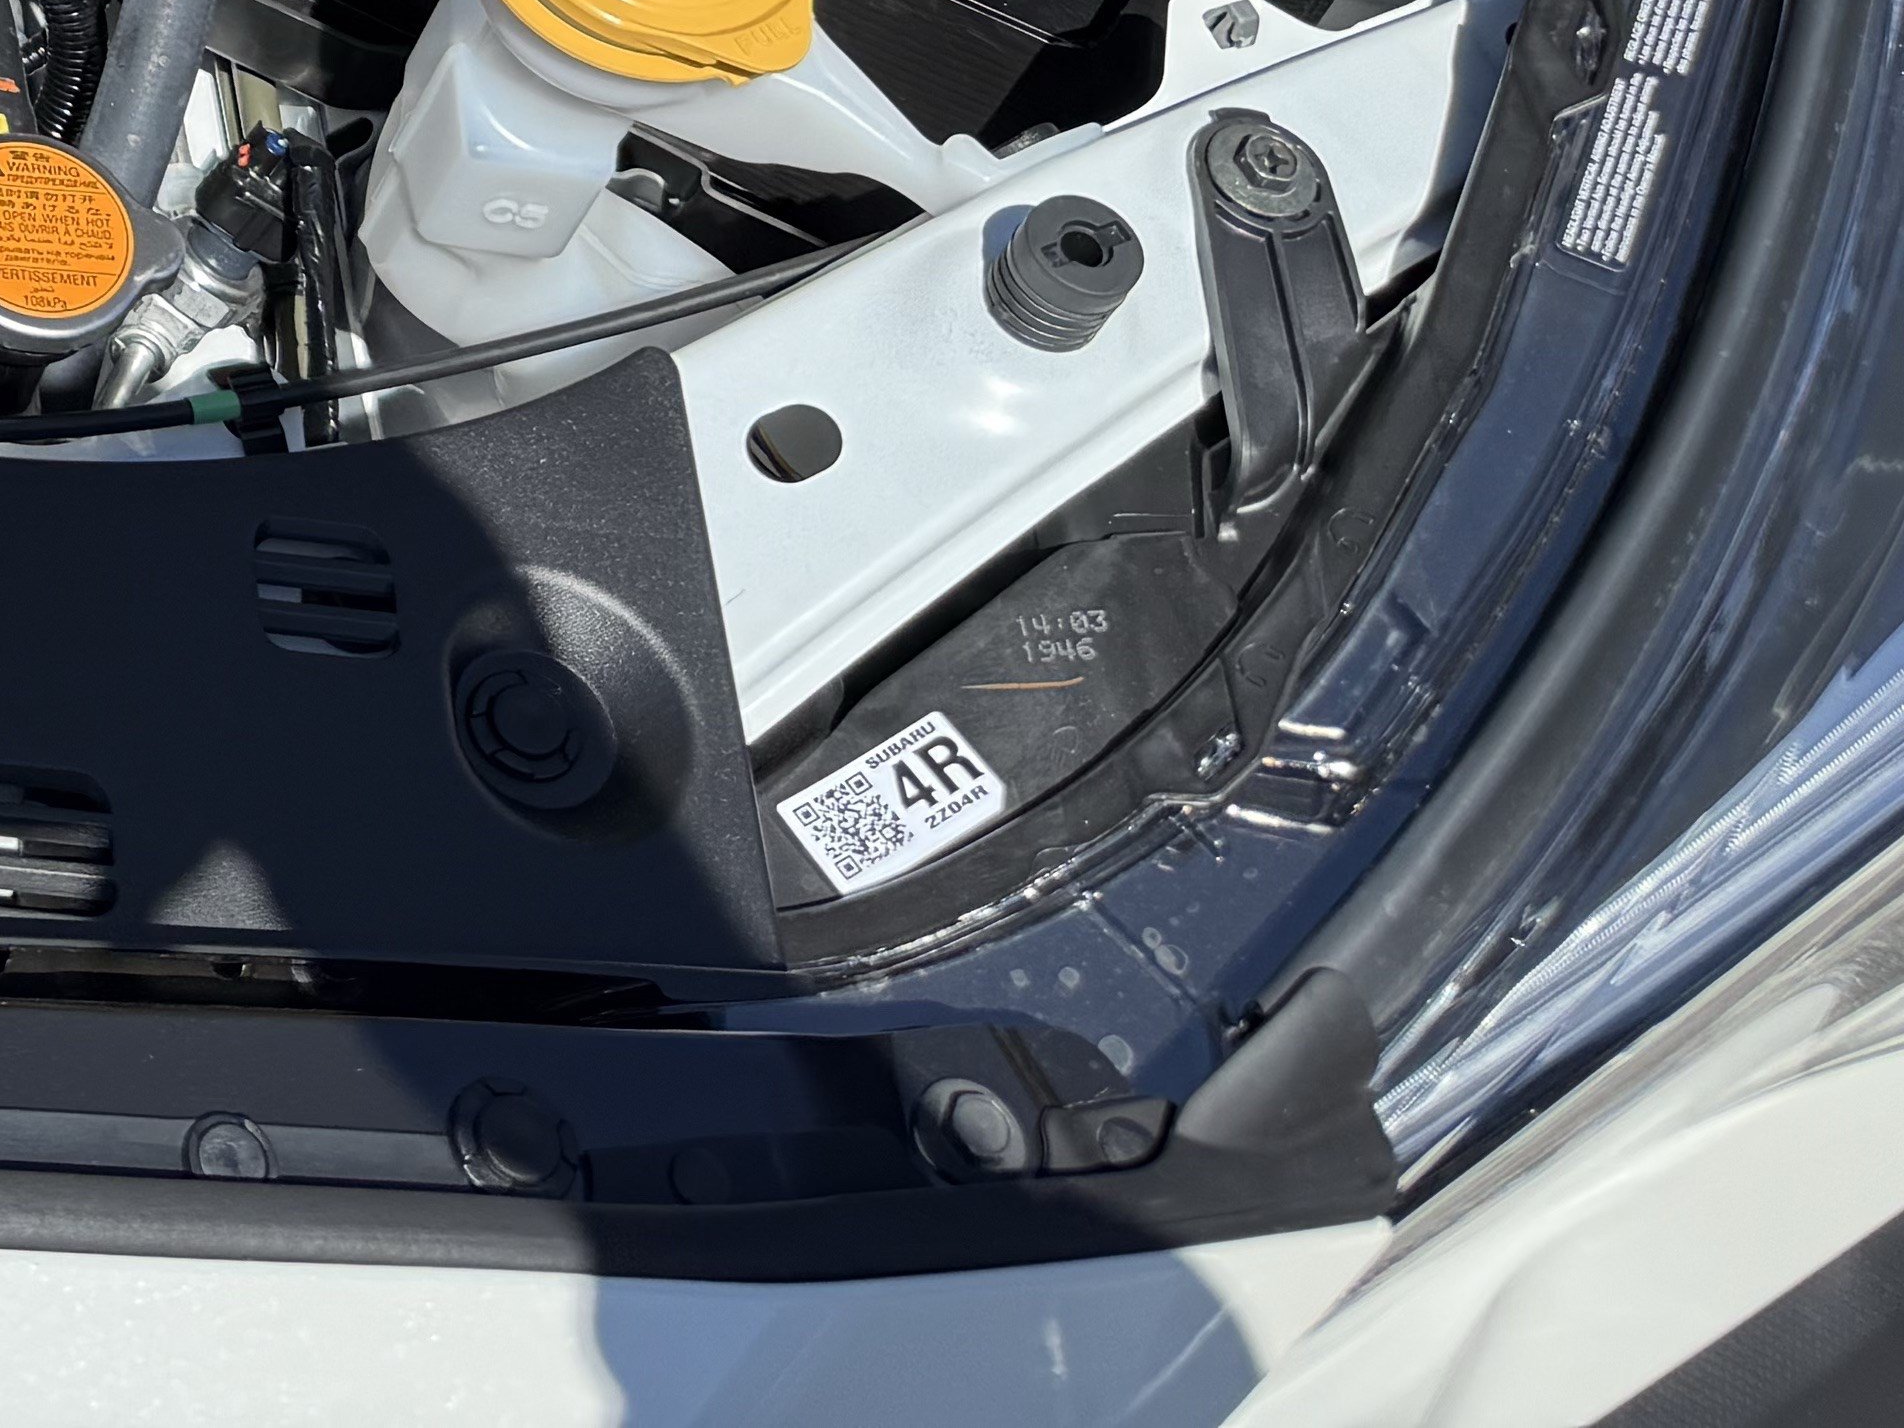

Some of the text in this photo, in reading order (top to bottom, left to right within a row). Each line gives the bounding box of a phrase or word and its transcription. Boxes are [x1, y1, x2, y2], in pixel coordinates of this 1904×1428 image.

[4, 160, 81, 178] WARNING
[1, 209, 37, 222] OPEN
[40, 212, 81, 227] WHEN
[84, 215, 111, 229] HOT
[1016, 610, 1108, 636] 14:03
[1022, 637, 1096, 662] 1946
[865, 721, 936, 769] SUBARU
[892, 725, 985, 809] 4R
